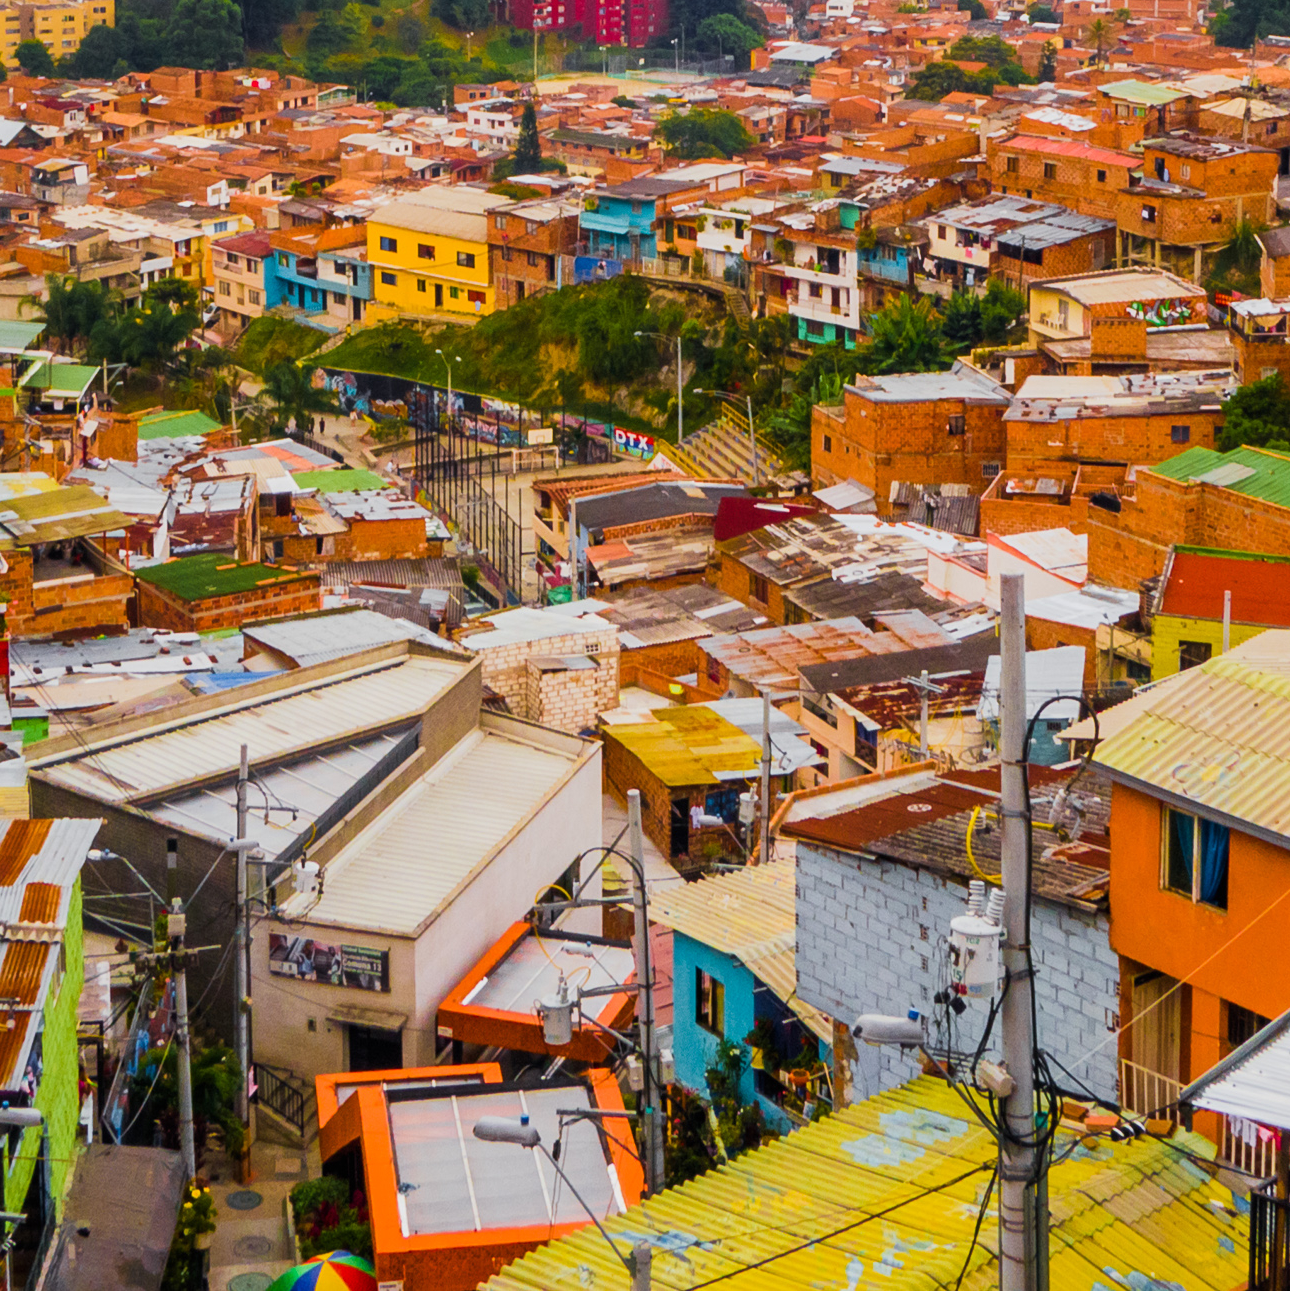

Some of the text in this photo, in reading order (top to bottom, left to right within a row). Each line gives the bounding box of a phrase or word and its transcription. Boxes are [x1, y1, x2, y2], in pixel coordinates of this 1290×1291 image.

[615, 429, 648, 450] DTX
[342, 958, 371, 970] Comuna
[373, 962, 382, 972] 13
